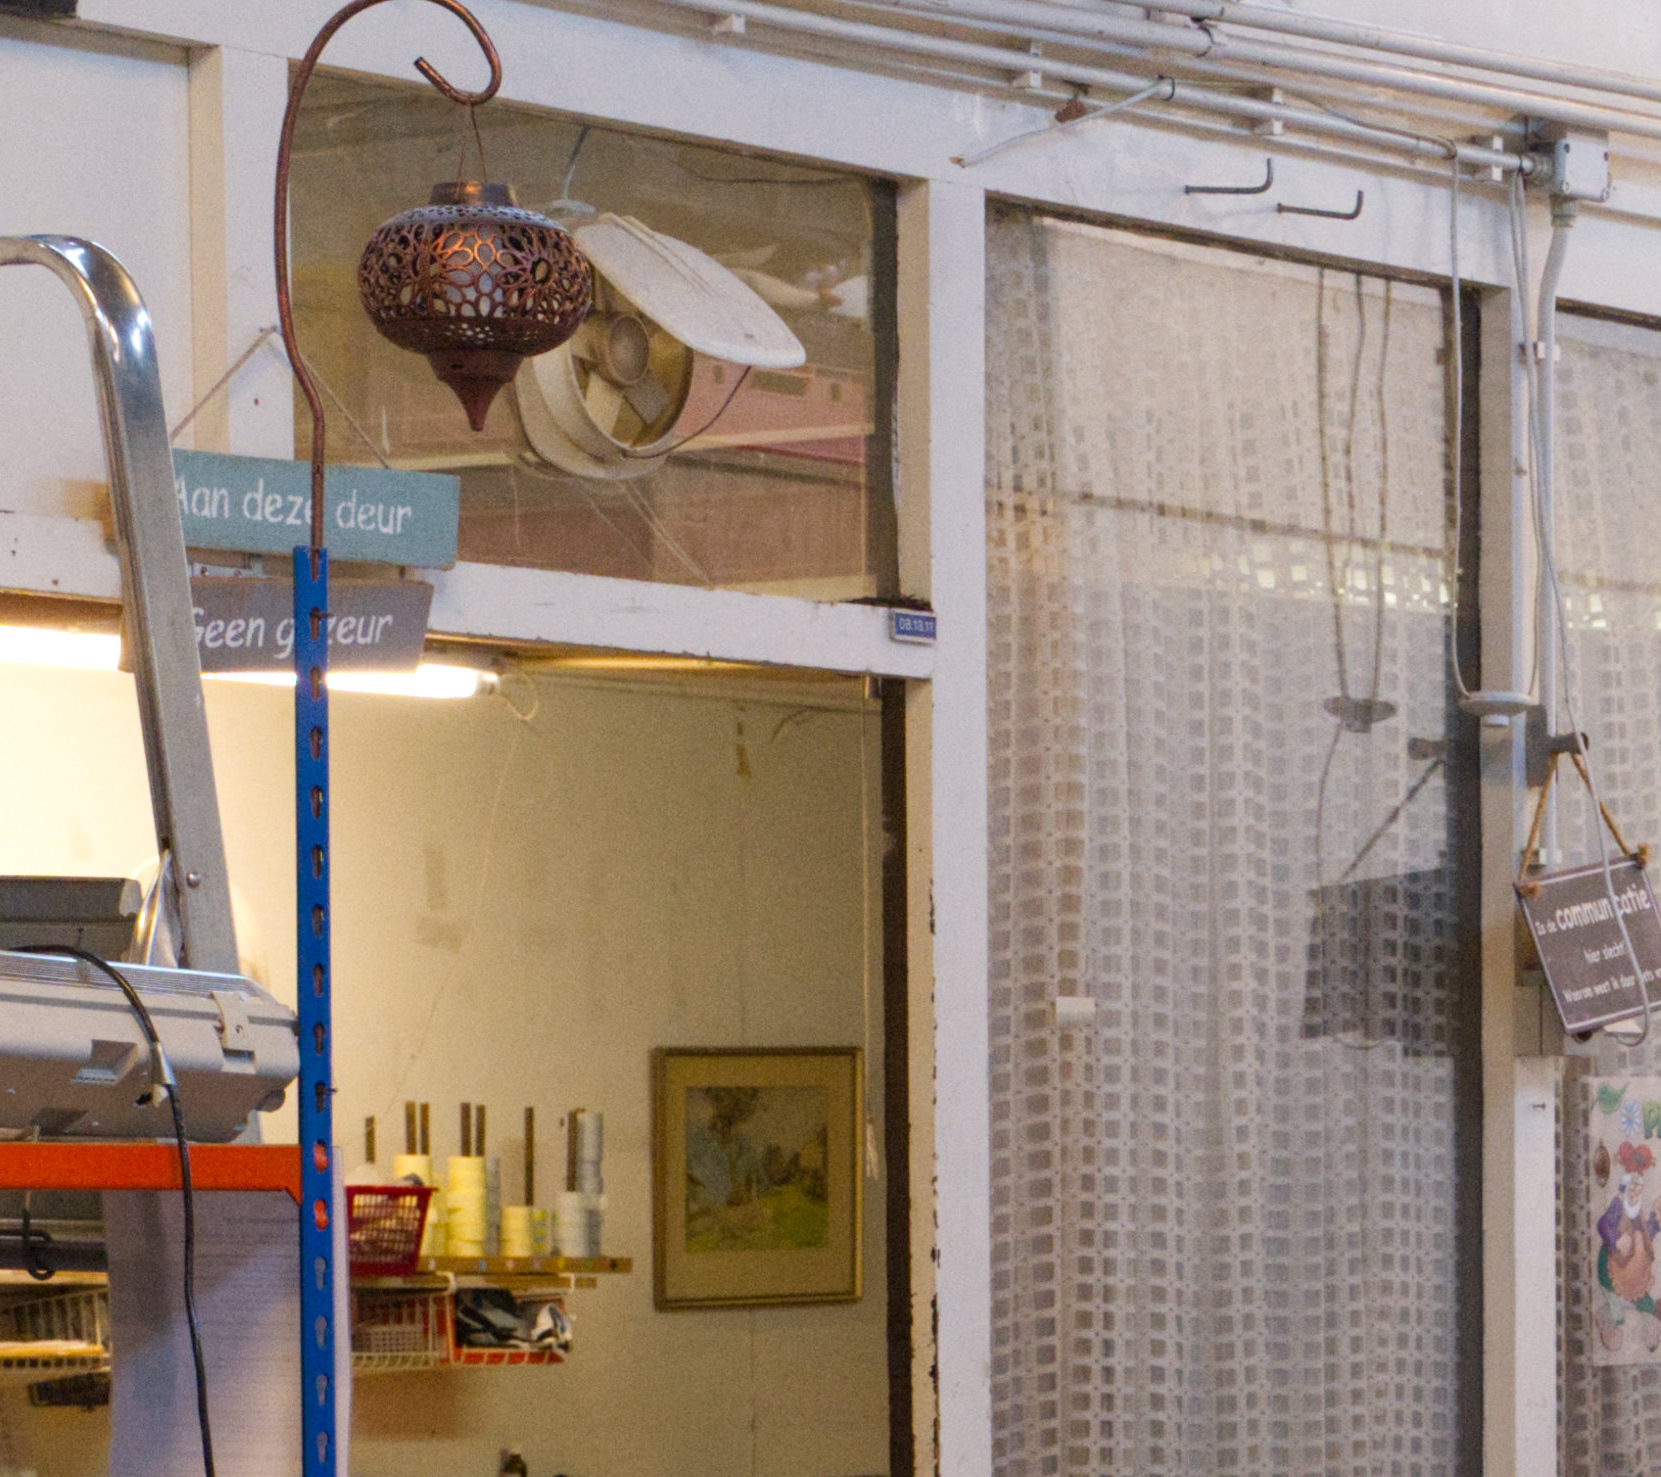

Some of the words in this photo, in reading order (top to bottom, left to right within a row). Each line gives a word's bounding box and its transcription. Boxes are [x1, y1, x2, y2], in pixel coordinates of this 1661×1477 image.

[175, 475, 230, 519] Aan
[336, 489, 413, 535] deur
[274, 612, 393, 660] gzeur
[1555, 883, 1651, 931] communcatie
